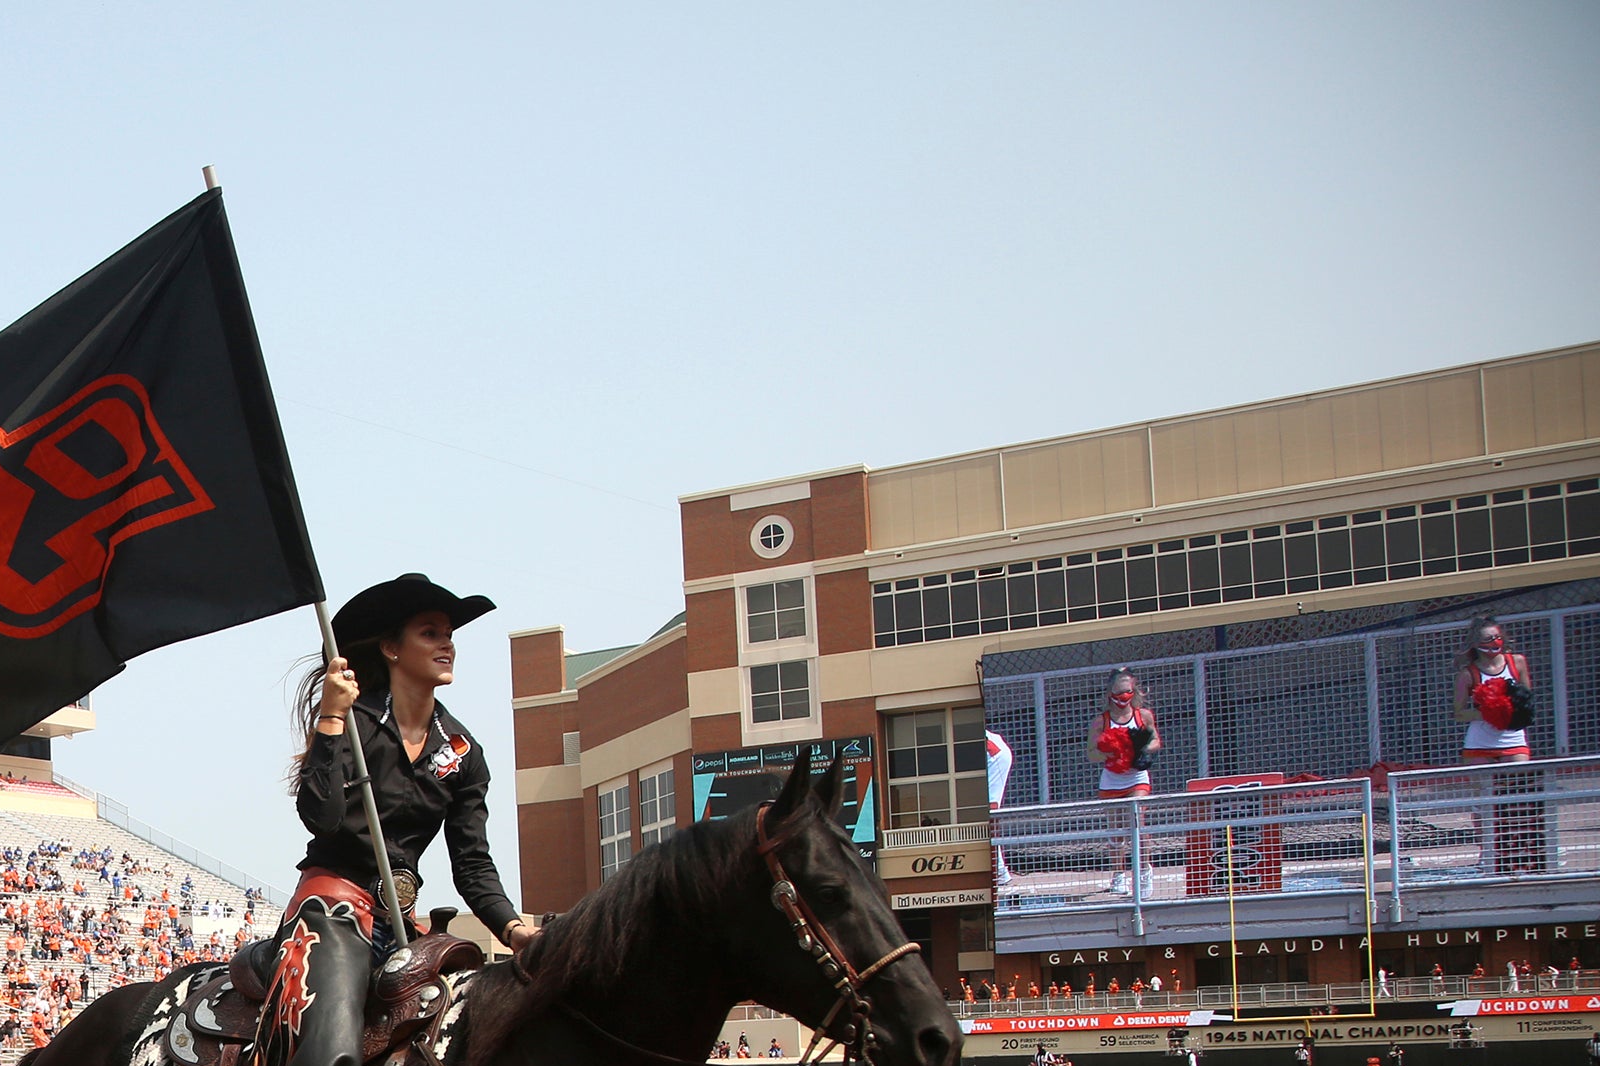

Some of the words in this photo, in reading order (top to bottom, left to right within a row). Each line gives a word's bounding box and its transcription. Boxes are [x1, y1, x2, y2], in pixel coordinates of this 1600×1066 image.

[704, 759, 724, 768] pepsi
[1048, 950, 1133, 965] GARY
[1164, 947, 1176, 959] &
[1207, 936, 1370, 957] CLAUDIA
[1010, 1017, 1099, 1030] TOUCHDOWN
[1127, 1016, 1157, 1026] DELTA
[1516, 1020, 1531, 1033] 11
[1532, 1019, 1582, 1027] CONFERENCE
[1532, 1025, 1594, 1033] CHAMPIONSHIPS
[1099, 1035, 1117, 1047] 59
[1206, 1031, 1248, 1043] 1945
[1253, 1027, 1344, 1042] NATIONAL
[1001, 1038, 1019, 1050] 20
